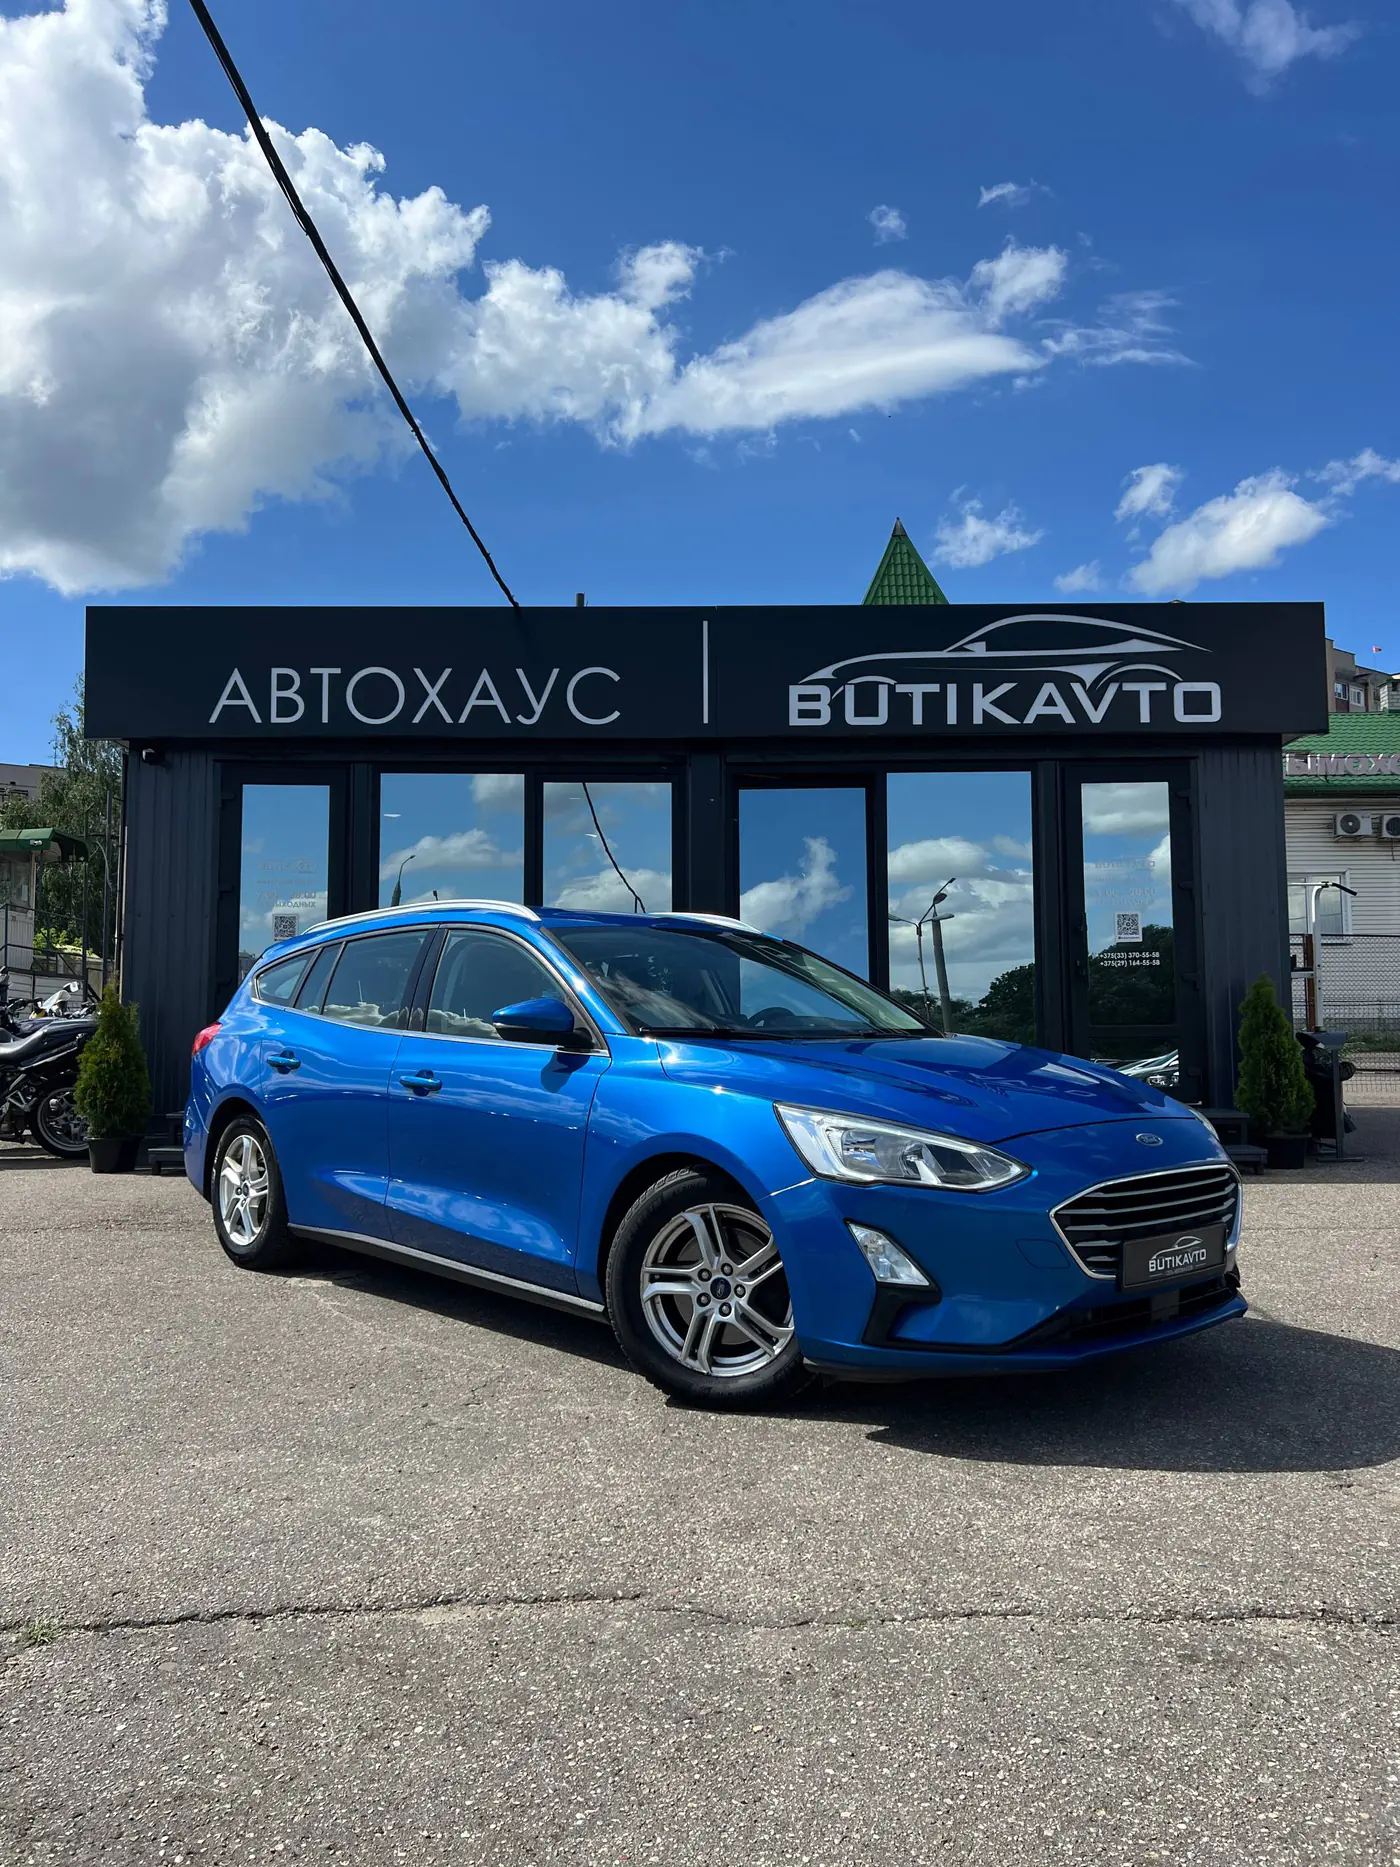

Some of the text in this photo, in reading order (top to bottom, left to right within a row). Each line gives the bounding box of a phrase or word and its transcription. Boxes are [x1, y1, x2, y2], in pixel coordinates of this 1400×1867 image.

[208, 667, 622, 725] АВТОХАУС
[788, 682, 1222, 726] BUTIKAVTO
[1100, 951, 1160, 960] +375(33) 370-55-58
[1129, 959, 1161, 967] 164-55-58
[1148, 1248, 1207, 1272] BUTIKAVTO
